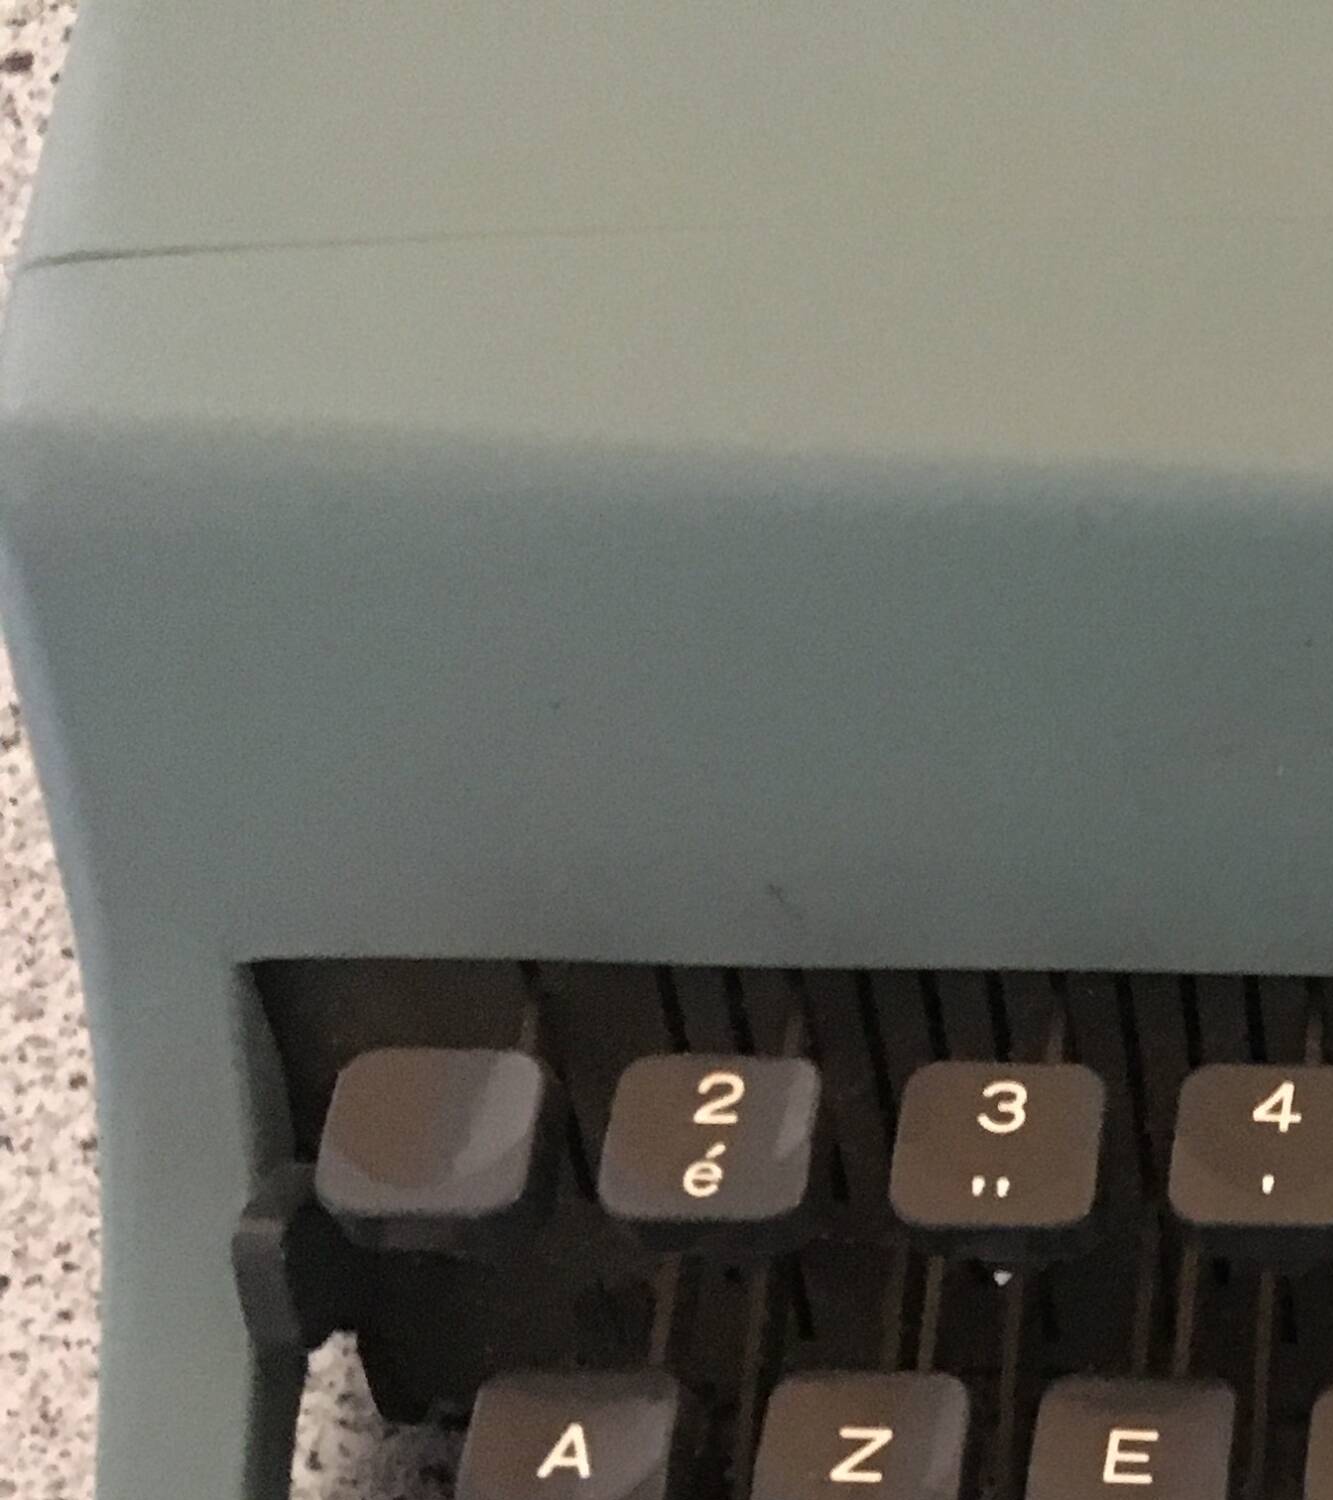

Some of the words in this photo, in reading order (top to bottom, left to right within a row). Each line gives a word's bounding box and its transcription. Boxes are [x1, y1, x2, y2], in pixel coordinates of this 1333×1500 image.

[691, 1071, 747, 1127] 2
[975, 1079, 1030, 1136] 3
[1250, 1080, 1304, 1135] 4
[681, 1141, 728, 1200] é
[534, 1421, 593, 1481] A
[827, 1425, 895, 1485] Z
[1100, 1427, 1161, 1486] E
